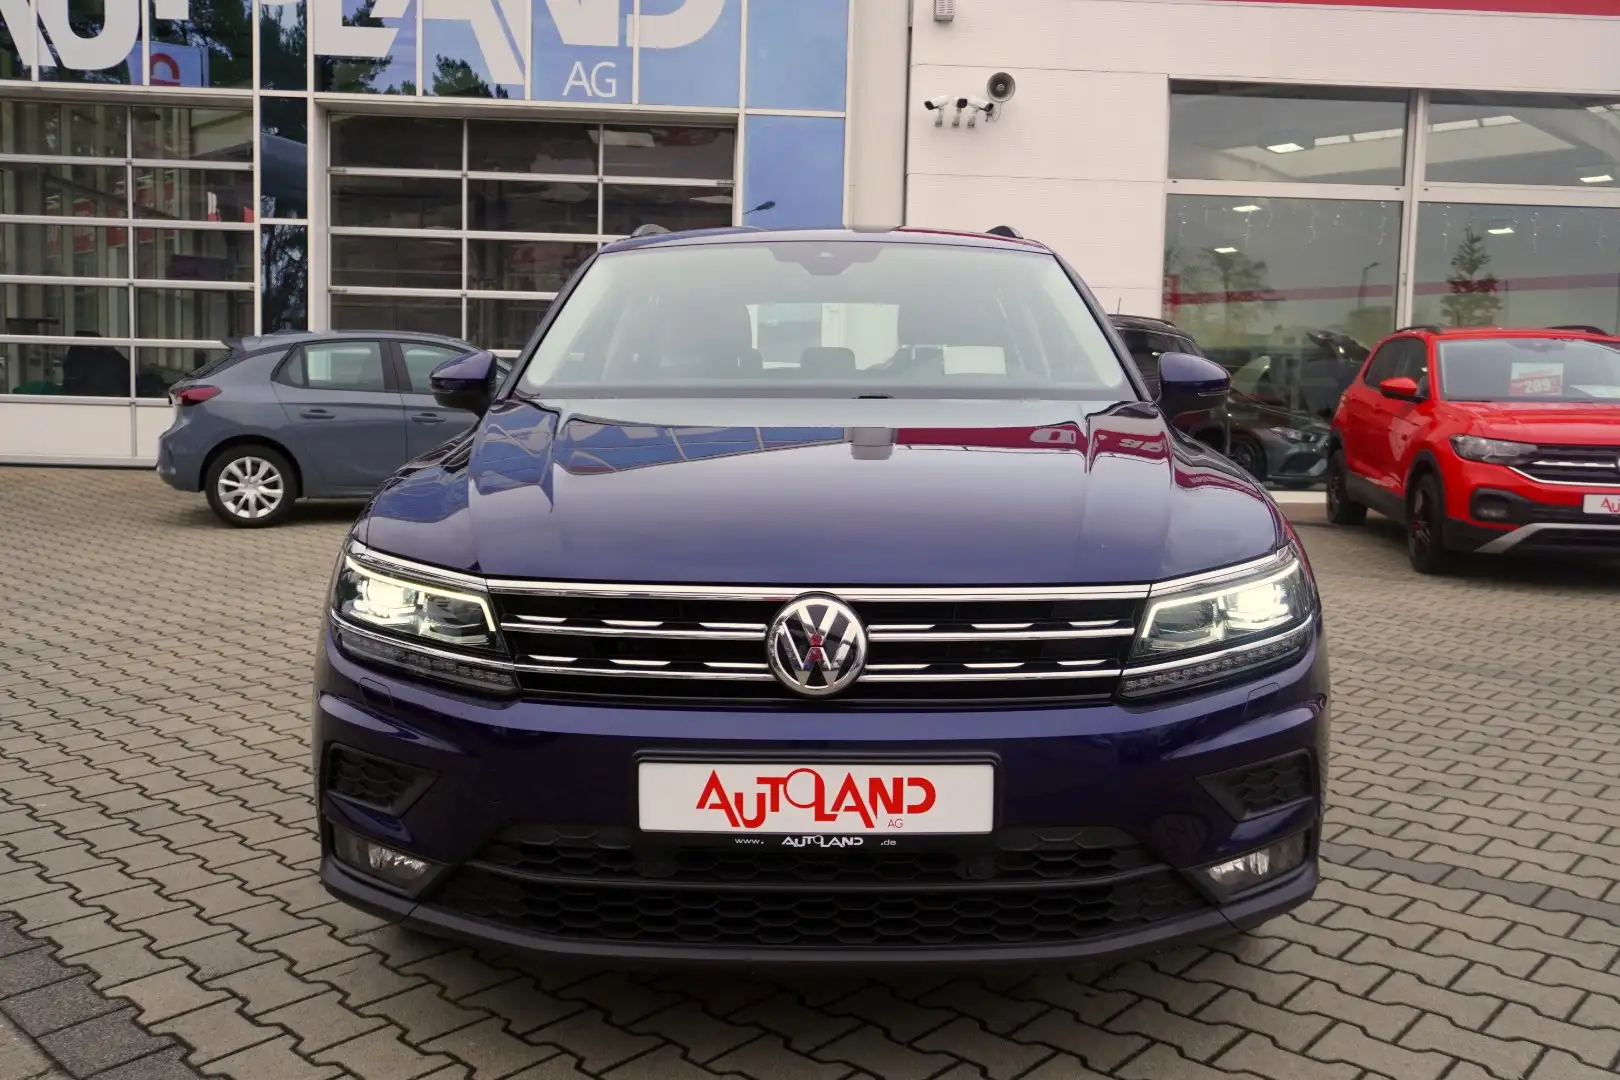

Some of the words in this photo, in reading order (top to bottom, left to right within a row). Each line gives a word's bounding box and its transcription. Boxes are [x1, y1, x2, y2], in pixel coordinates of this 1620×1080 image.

[562, 61, 617, 98] AG
[768, 598, 867, 695] VW
[887, 818, 903, 829] AG
[734, 837, 764, 845] www.
[880, 838, 897, 846] .de
